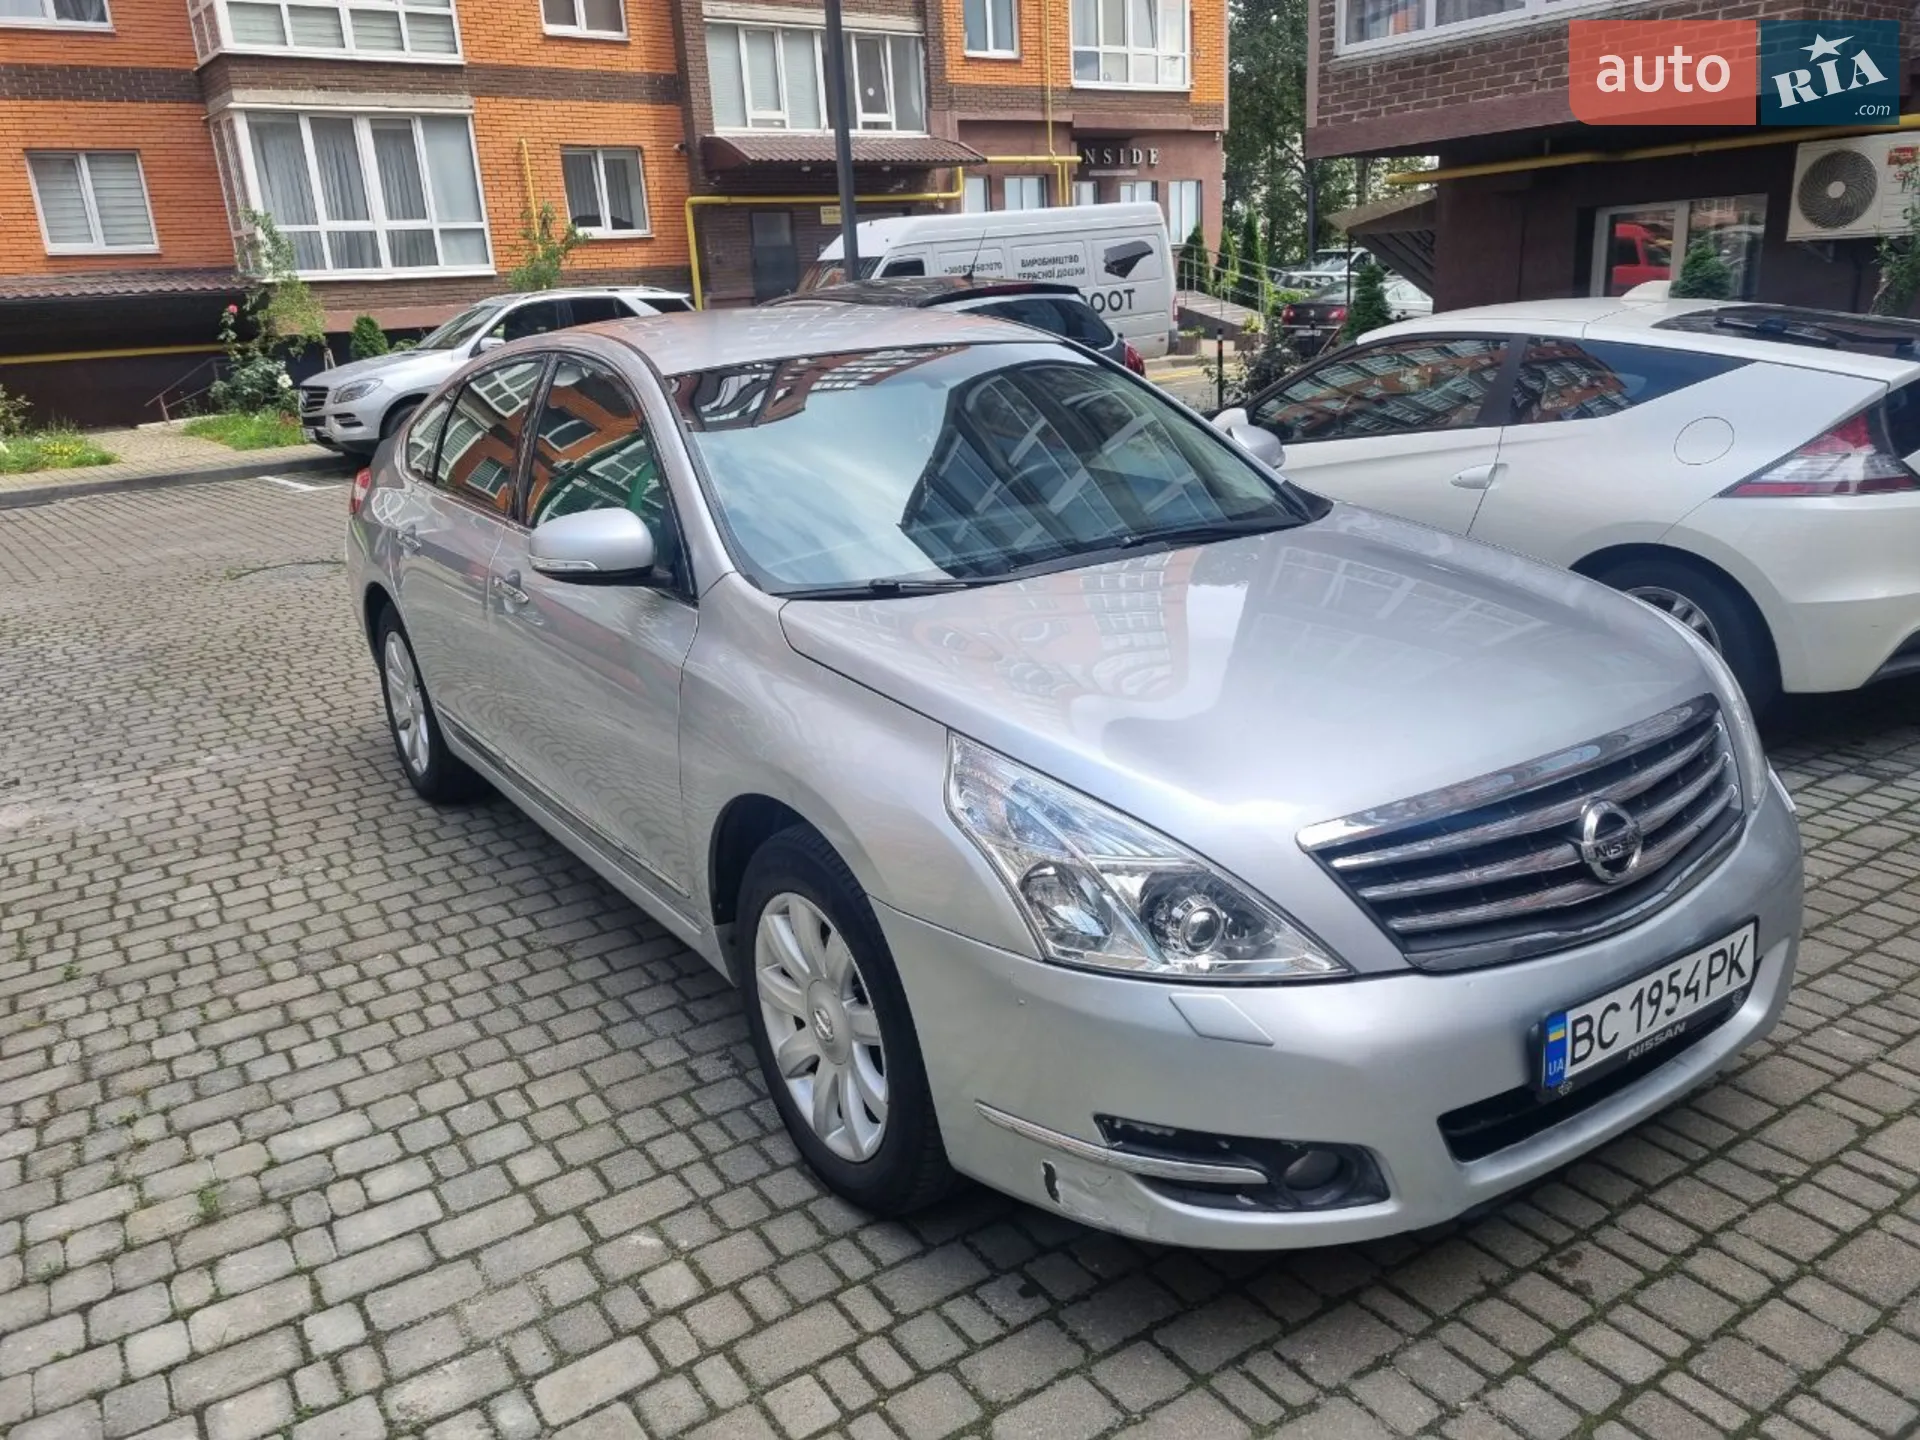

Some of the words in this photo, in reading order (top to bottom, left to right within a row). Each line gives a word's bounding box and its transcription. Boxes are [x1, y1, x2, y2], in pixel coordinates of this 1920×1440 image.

[1084, 147, 1159, 165] NSIDE
[1056, 266, 1086, 279] ДОШКИ
[1627, 1021, 1687, 1060] NISSAN
[1548, 1056, 1564, 1076] UA
